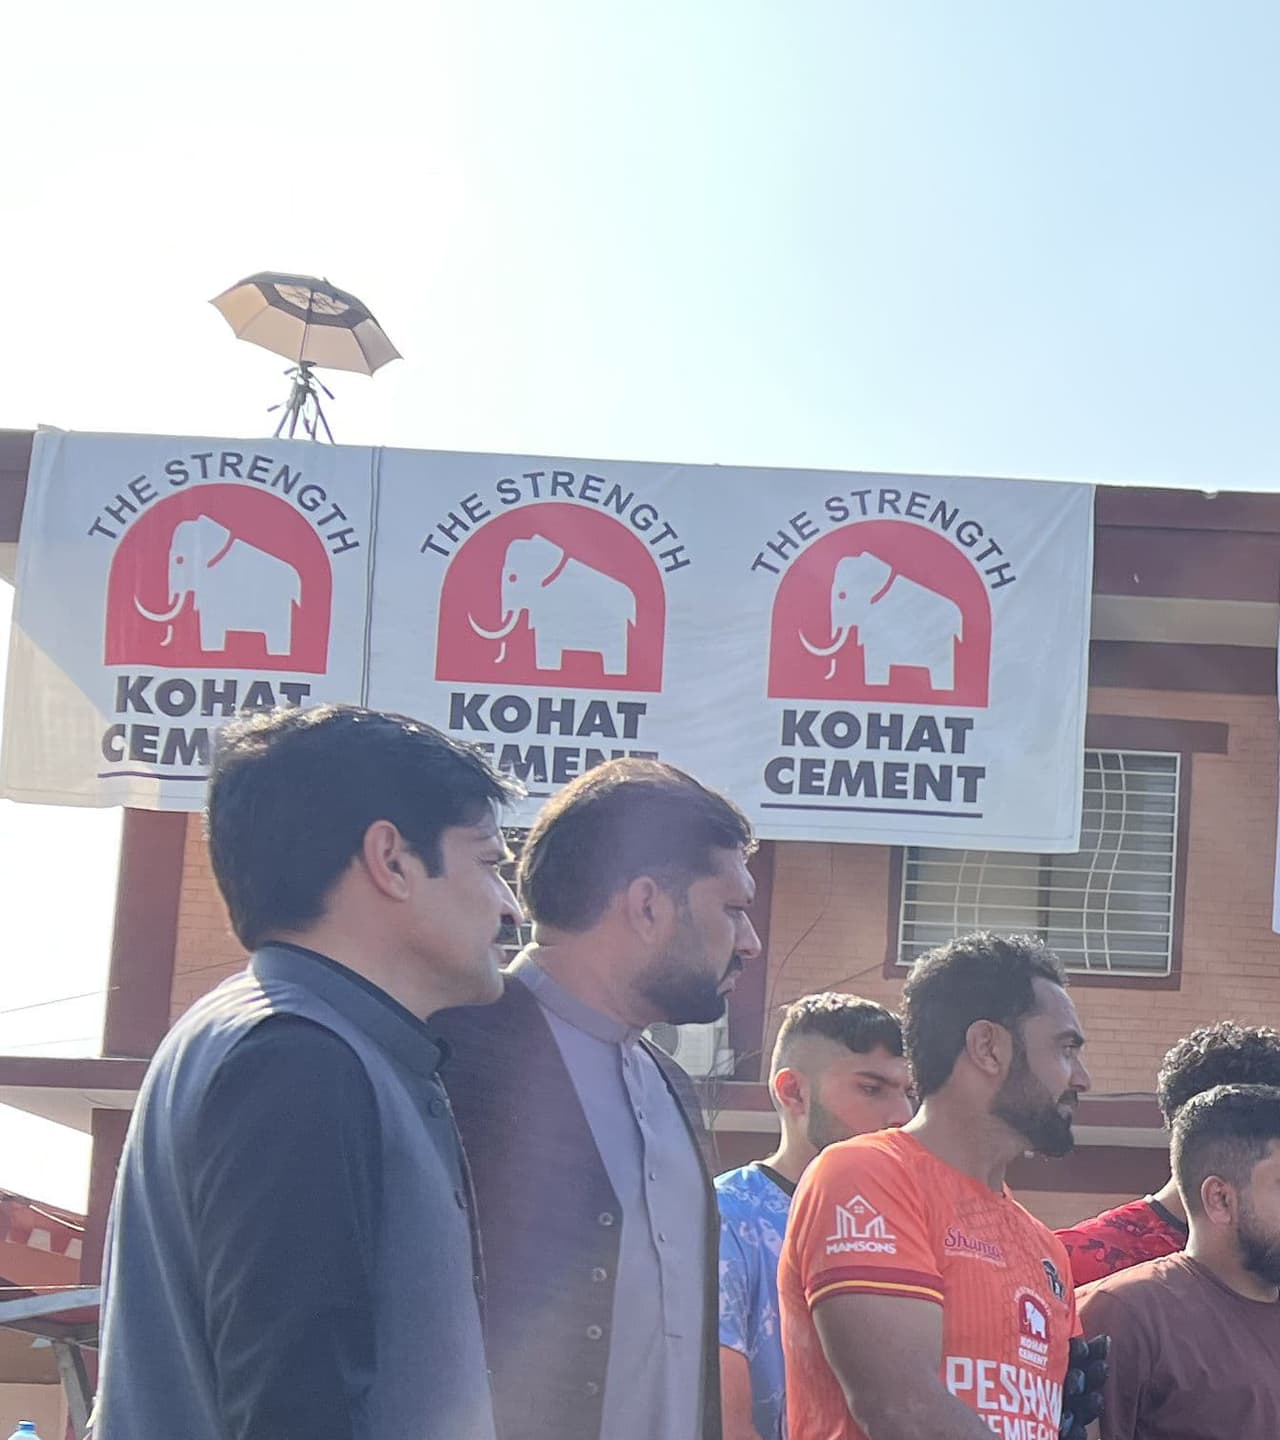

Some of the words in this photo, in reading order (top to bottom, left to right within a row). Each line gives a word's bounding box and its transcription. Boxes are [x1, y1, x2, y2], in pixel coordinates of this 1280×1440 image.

[88, 475, 159, 543] THE
[164, 451, 360, 556] STRENGTH
[420, 493, 491, 558] THE
[496, 470, 691, 573] STRENGTH
[750, 511, 820, 575] THE
[824, 488, 1017, 590] STRENGTH
[449, 692, 648, 739] KOHAT
[781, 709, 975, 754] KOHAT
[101, 723, 210, 766] CEM
[763, 756, 986, 803] CEMENT
[826, 1242, 897, 1255] MAMSONS
